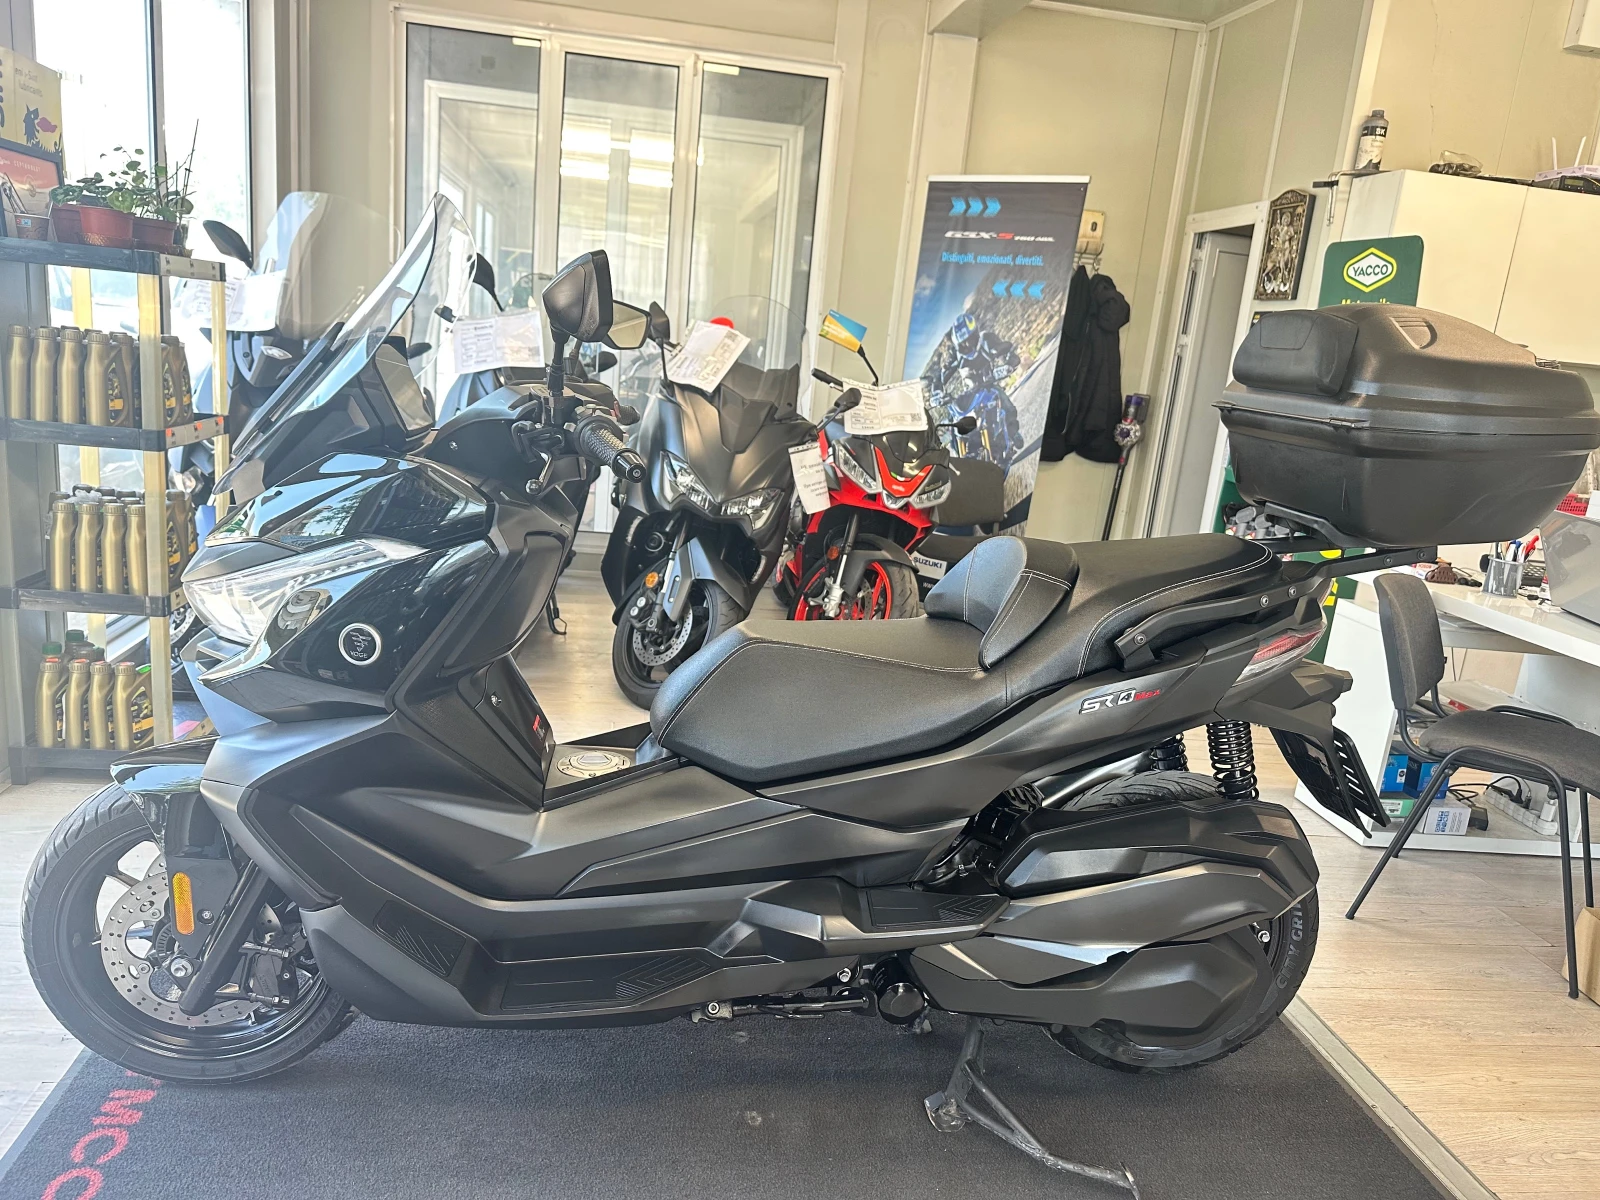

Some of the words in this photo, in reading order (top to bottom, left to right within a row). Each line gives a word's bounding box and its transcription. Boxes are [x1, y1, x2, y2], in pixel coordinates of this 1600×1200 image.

[941, 251, 975, 264] Distinguiti,
[976, 253, 1014, 267] emozionati,
[1015, 254, 1044, 266] divertiti.
[1352, 264, 1389, 277] YACCO
[913, 556, 943, 569] SUZUKI
[350, 650, 368, 659] VOGE
[1276, 943, 1300, 989] CITY
